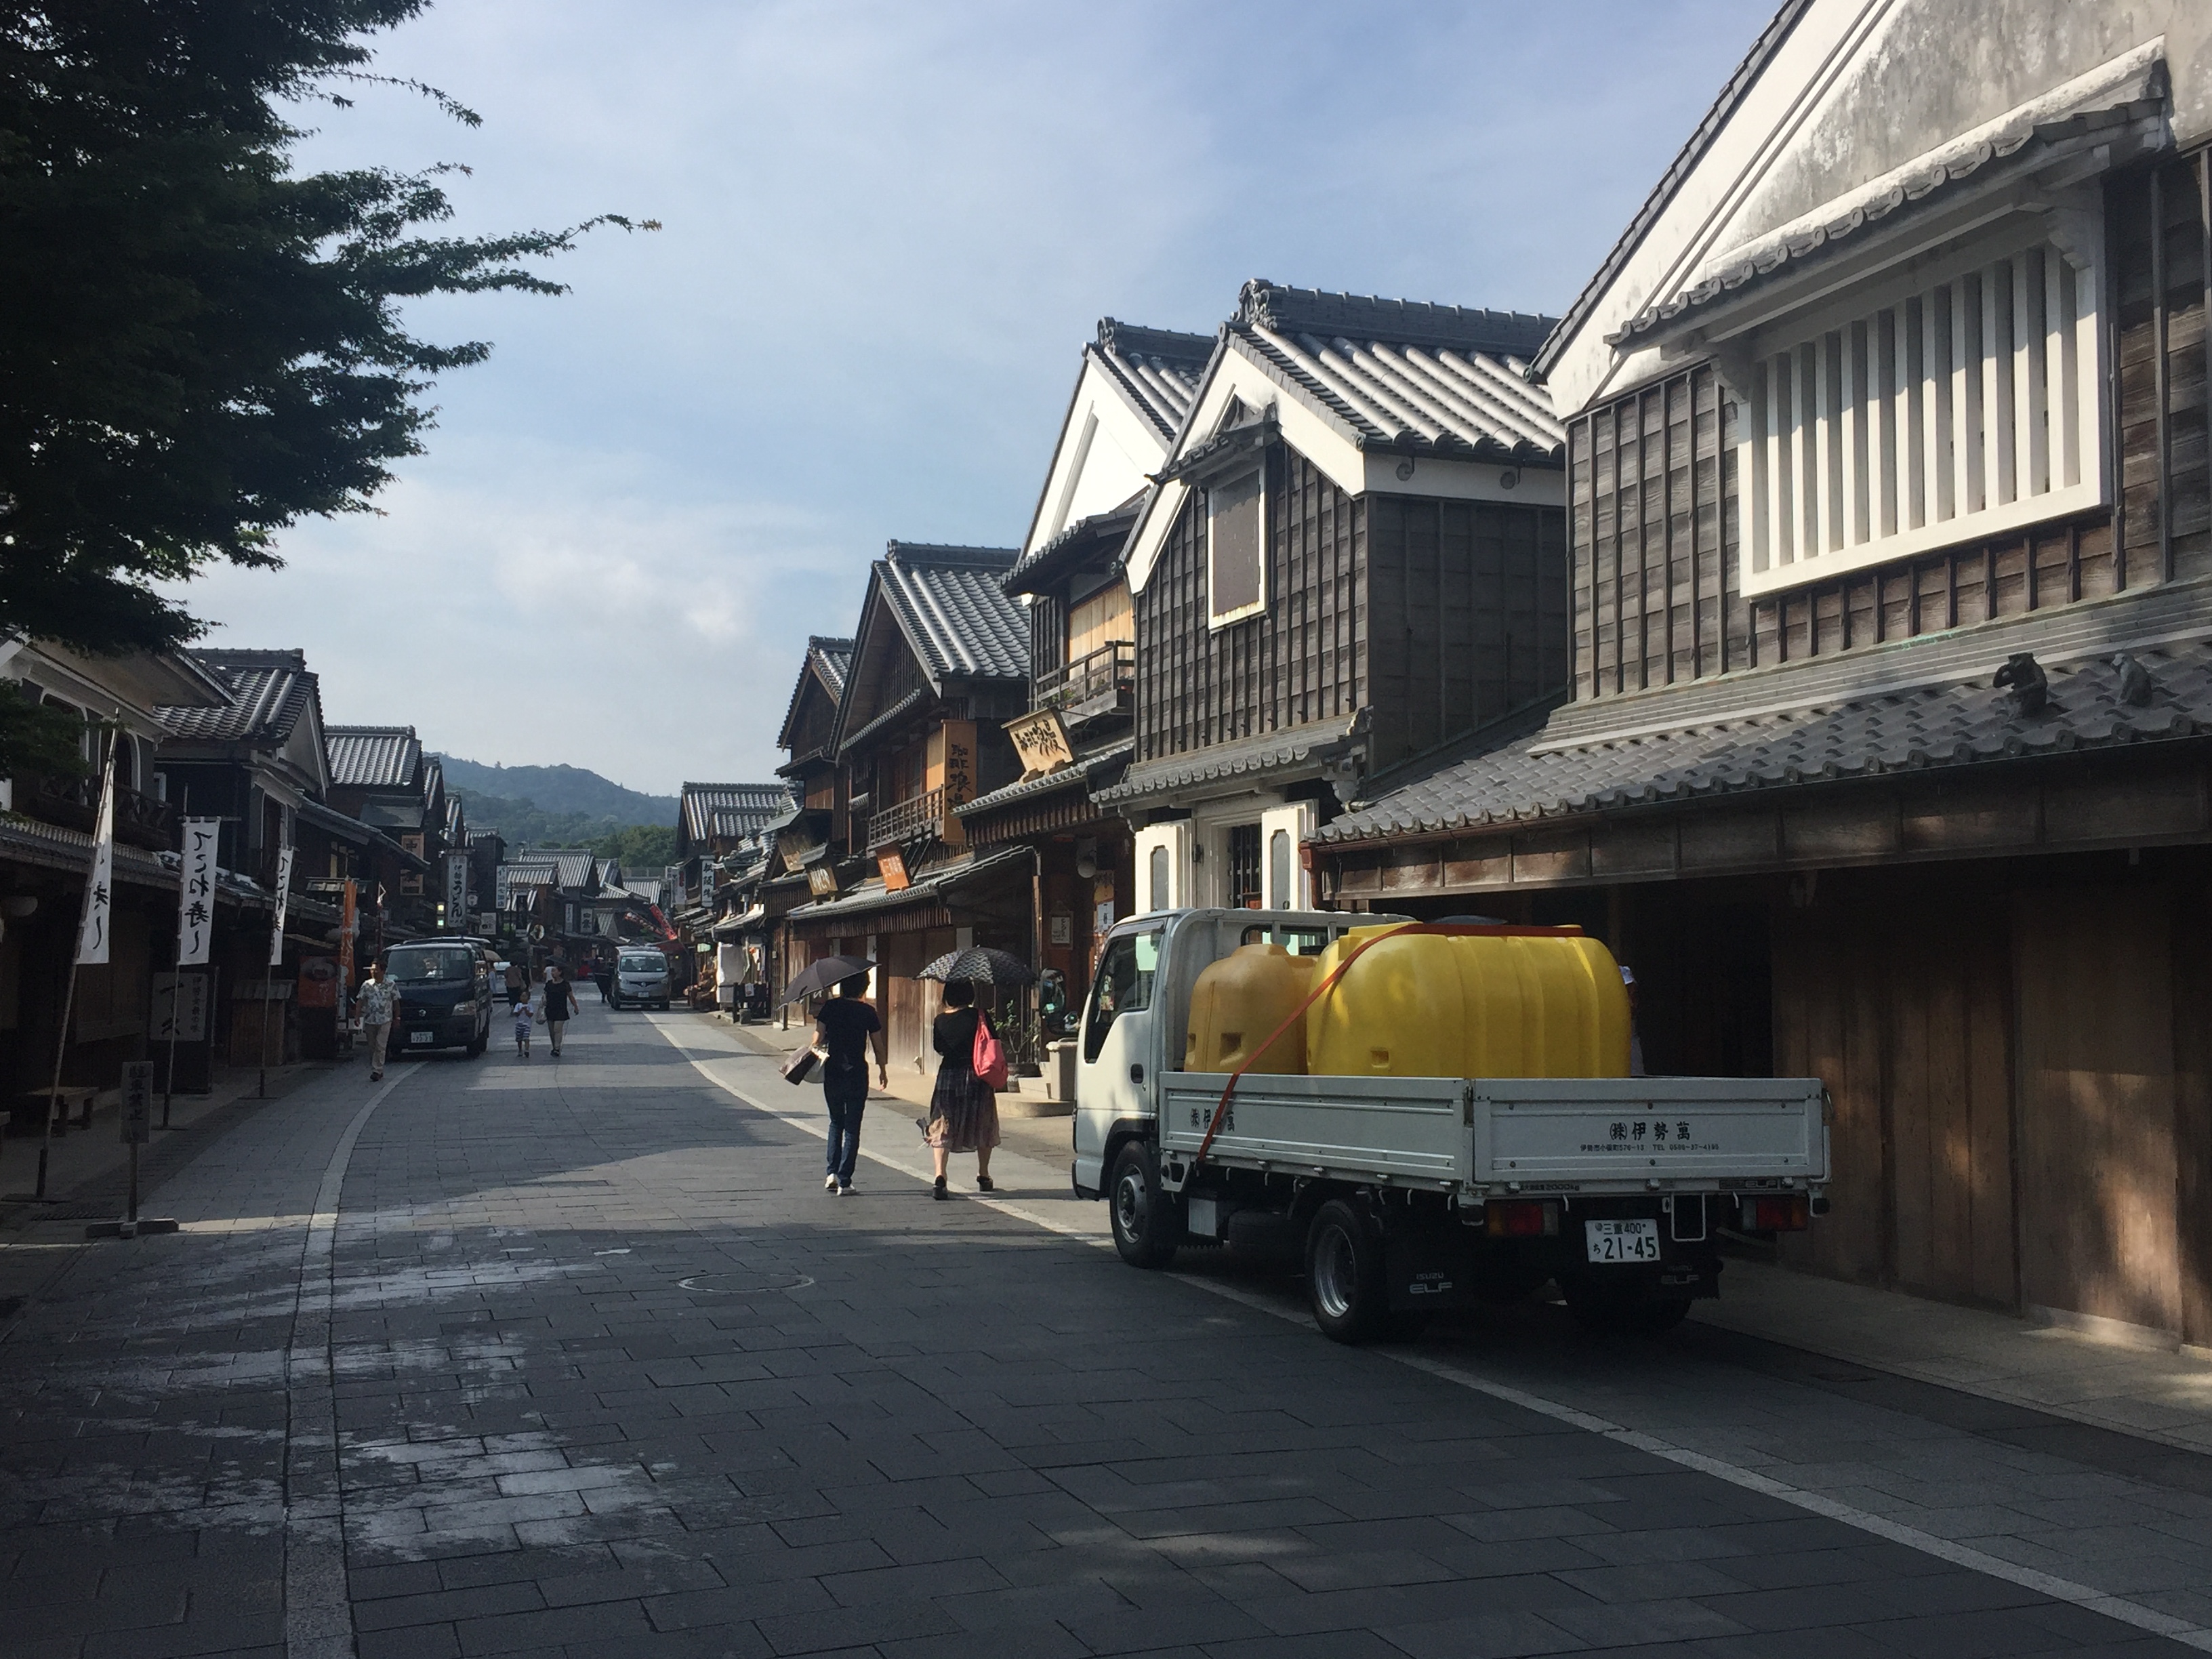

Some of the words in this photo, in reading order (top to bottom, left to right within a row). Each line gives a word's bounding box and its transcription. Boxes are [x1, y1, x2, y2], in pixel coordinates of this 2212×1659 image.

[128, 1065, 146, 1121] 駐車禁止
[1603, 1223, 1623, 1235] 三重
[1624, 1223, 1641, 1234] 400
[1593, 1243, 1601, 1254] ち
[1603, 1237, 1656, 1259] 21-45
[1416, 1271, 1444, 1280] ISUZU
[1410, 1282, 1453, 1294] ELF
